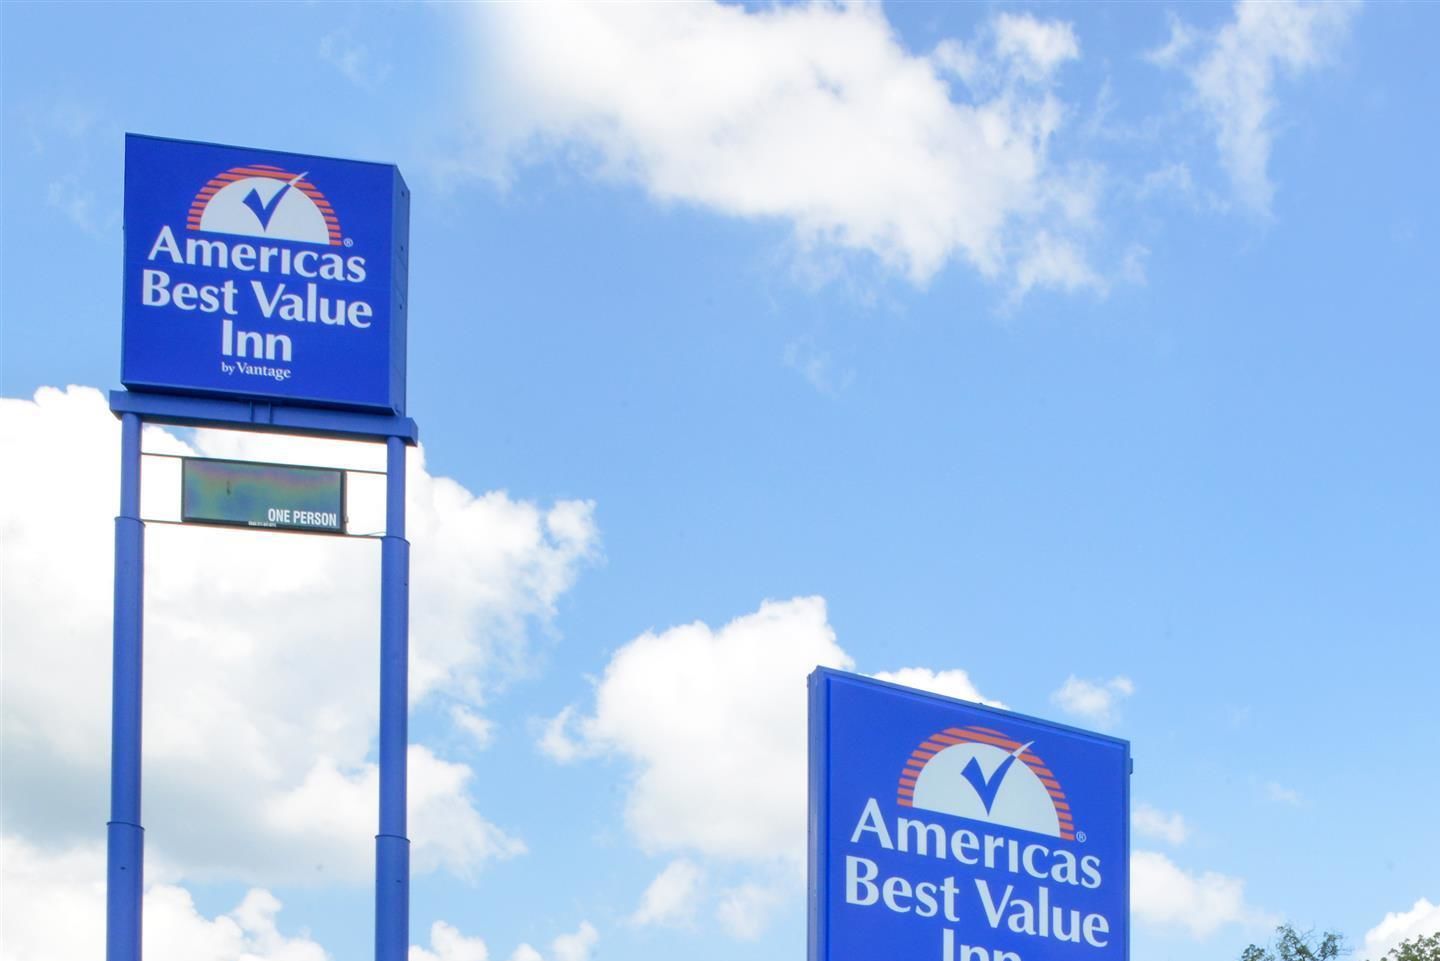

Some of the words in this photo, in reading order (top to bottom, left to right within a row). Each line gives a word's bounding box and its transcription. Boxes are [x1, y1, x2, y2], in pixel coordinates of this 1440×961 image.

[148, 225, 367, 283] Americas
[142, 268, 238, 315] Best
[250, 280, 373, 329] Value
[221, 319, 292, 362] Inn
[221, 361, 235, 376] by
[236, 361, 292, 381] Vantage
[268, 508, 290, 522] ONE
[293, 510, 337, 526] PERSON
[850, 797, 1102, 889] Americas
[845, 855, 960, 922] Best
[974, 878, 1110, 948] Value
